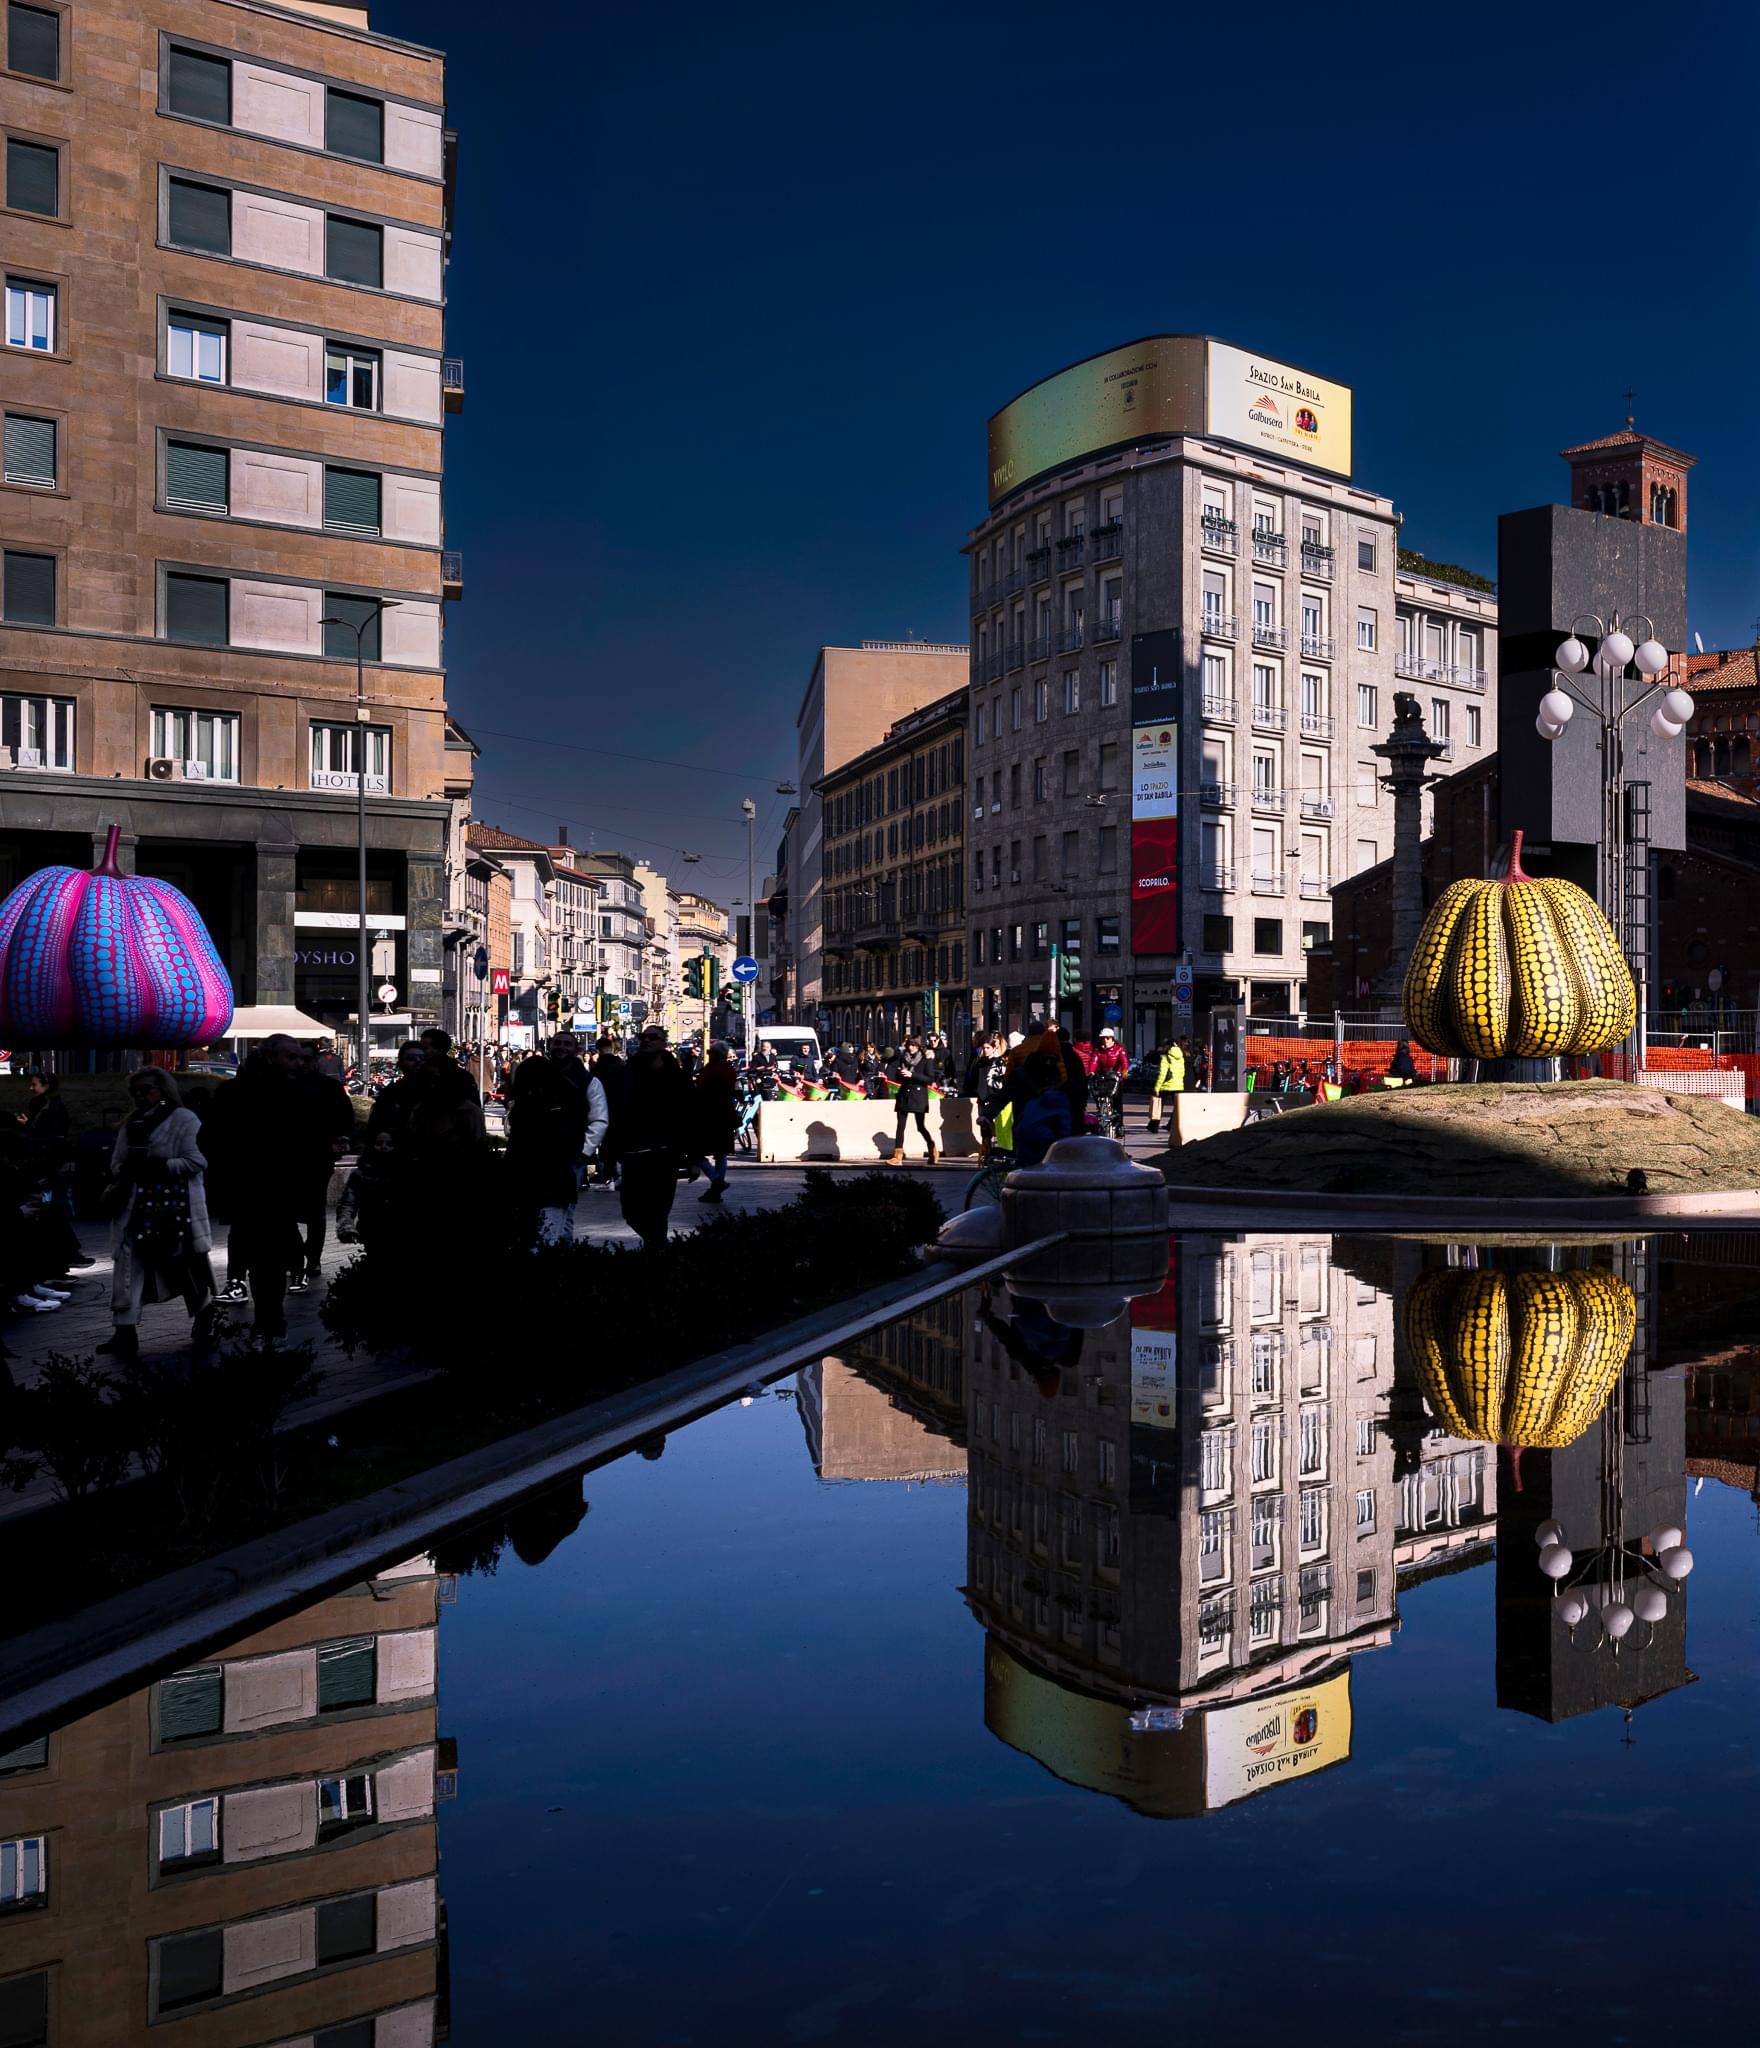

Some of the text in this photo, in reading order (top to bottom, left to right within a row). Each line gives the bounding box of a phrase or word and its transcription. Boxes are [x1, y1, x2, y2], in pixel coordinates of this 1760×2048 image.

[1250, 365, 1321, 401] SPAZIO SAN BABILA
[1248, 408, 1283, 429] Galbusera
[317, 774, 384, 790] HOTLS
[1141, 783, 1149, 791] LO
[1138, 877, 1170, 887] SCOPRILO.
[494, 974, 508, 989] M
[621, 1004, 628, 1012] P
